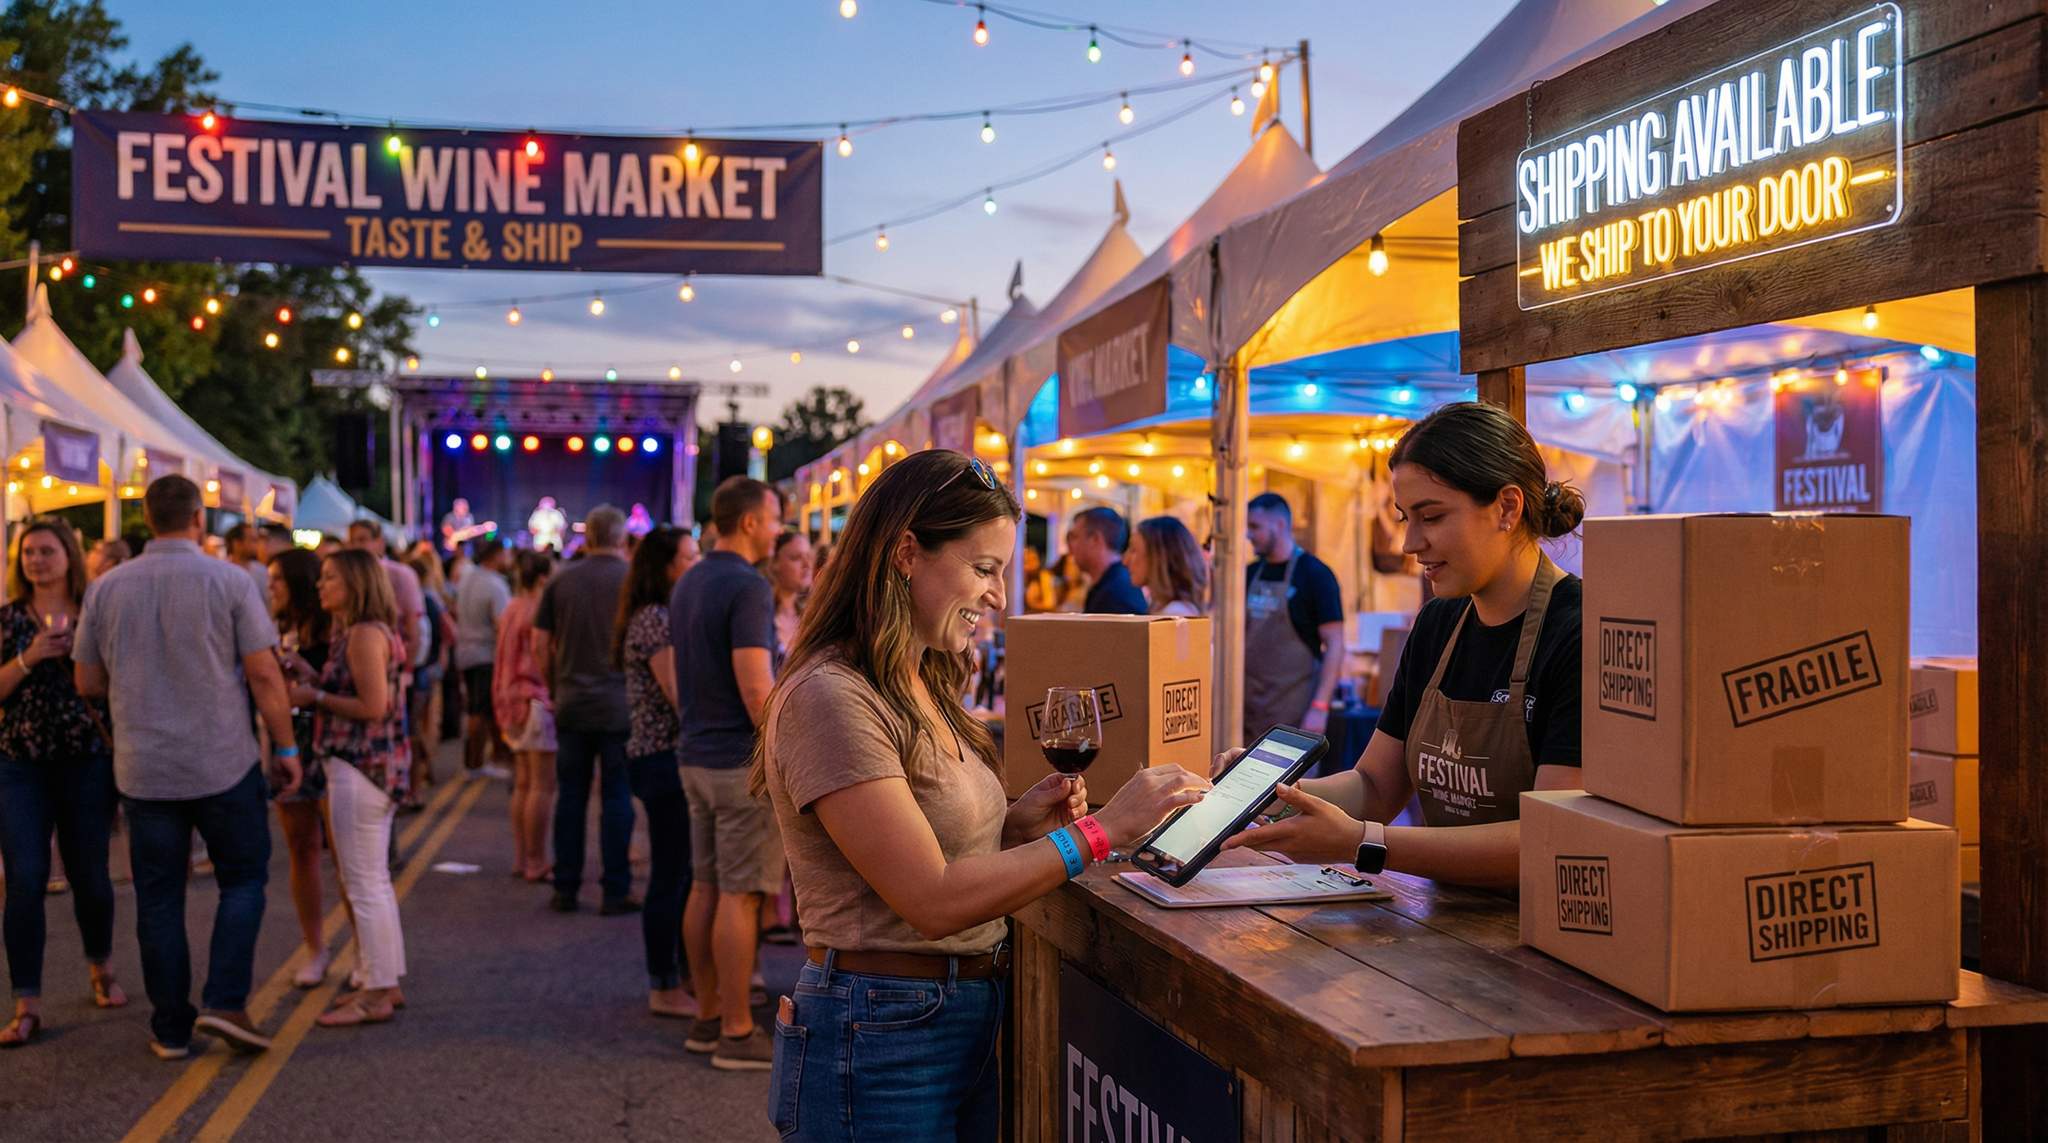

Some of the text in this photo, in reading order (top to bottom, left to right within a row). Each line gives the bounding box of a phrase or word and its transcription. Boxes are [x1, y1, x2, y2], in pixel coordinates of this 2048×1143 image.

[1517, 21, 1889, 235] SHIPPING AVAILABLE
[117, 131, 787, 220] FESTIVAL WINE MARKET
[344, 216, 583, 263] TASTE & SHIP
[1541, 155, 1850, 291] WE SHIP TO YOUR DOOR
[1783, 463, 1872, 506] FESTIVAL
[1602, 628, 1652, 673] DIRECT
[1165, 686, 1198, 714] DIRECT
[1602, 671, 1653, 708] SHIPPING
[1734, 644, 1869, 714] FRAGILE
[1418, 751, 1496, 797] FESTIVAL
[1559, 864, 1606, 897] DIRECT
[1756, 872, 1864, 921] DIRECT
[1560, 898, 1609, 927] SHIPPING
[1759, 912, 1869, 952] SHIPPING
